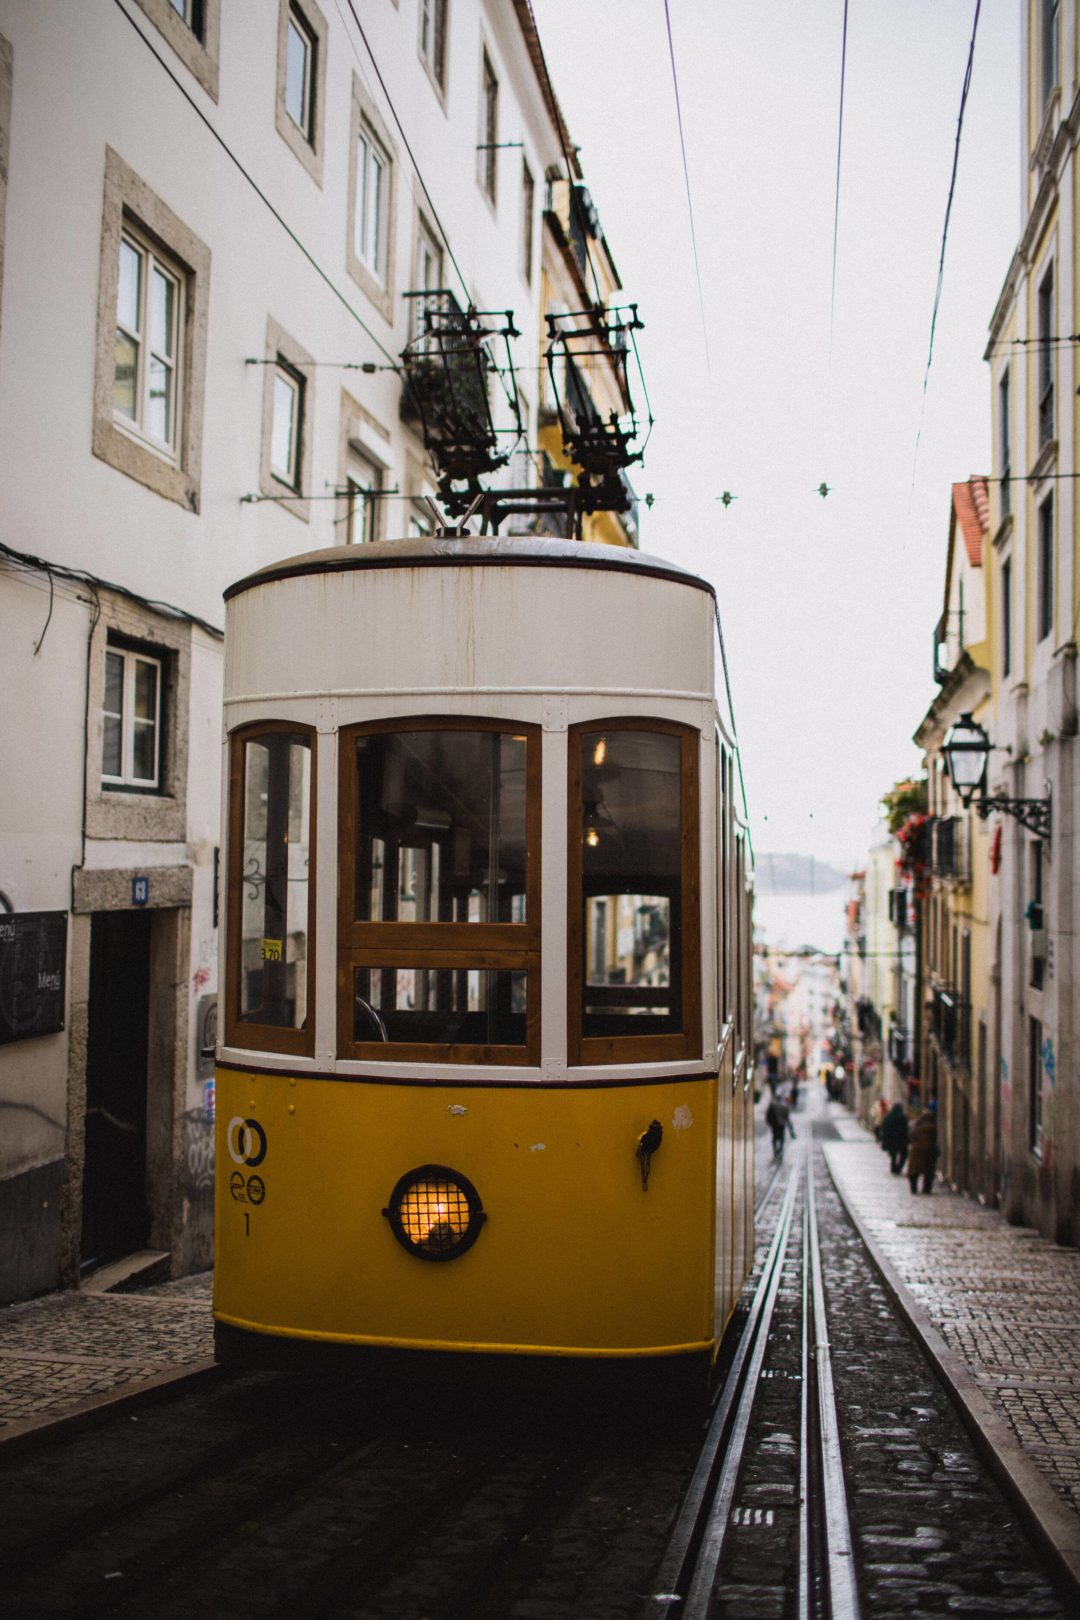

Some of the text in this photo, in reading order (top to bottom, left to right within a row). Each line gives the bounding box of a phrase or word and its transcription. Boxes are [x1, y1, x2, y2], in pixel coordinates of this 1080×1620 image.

[0, 919, 16, 936] enú
[260, 948, 280, 960] 3.70
[38, 969, 61, 989] Menú
